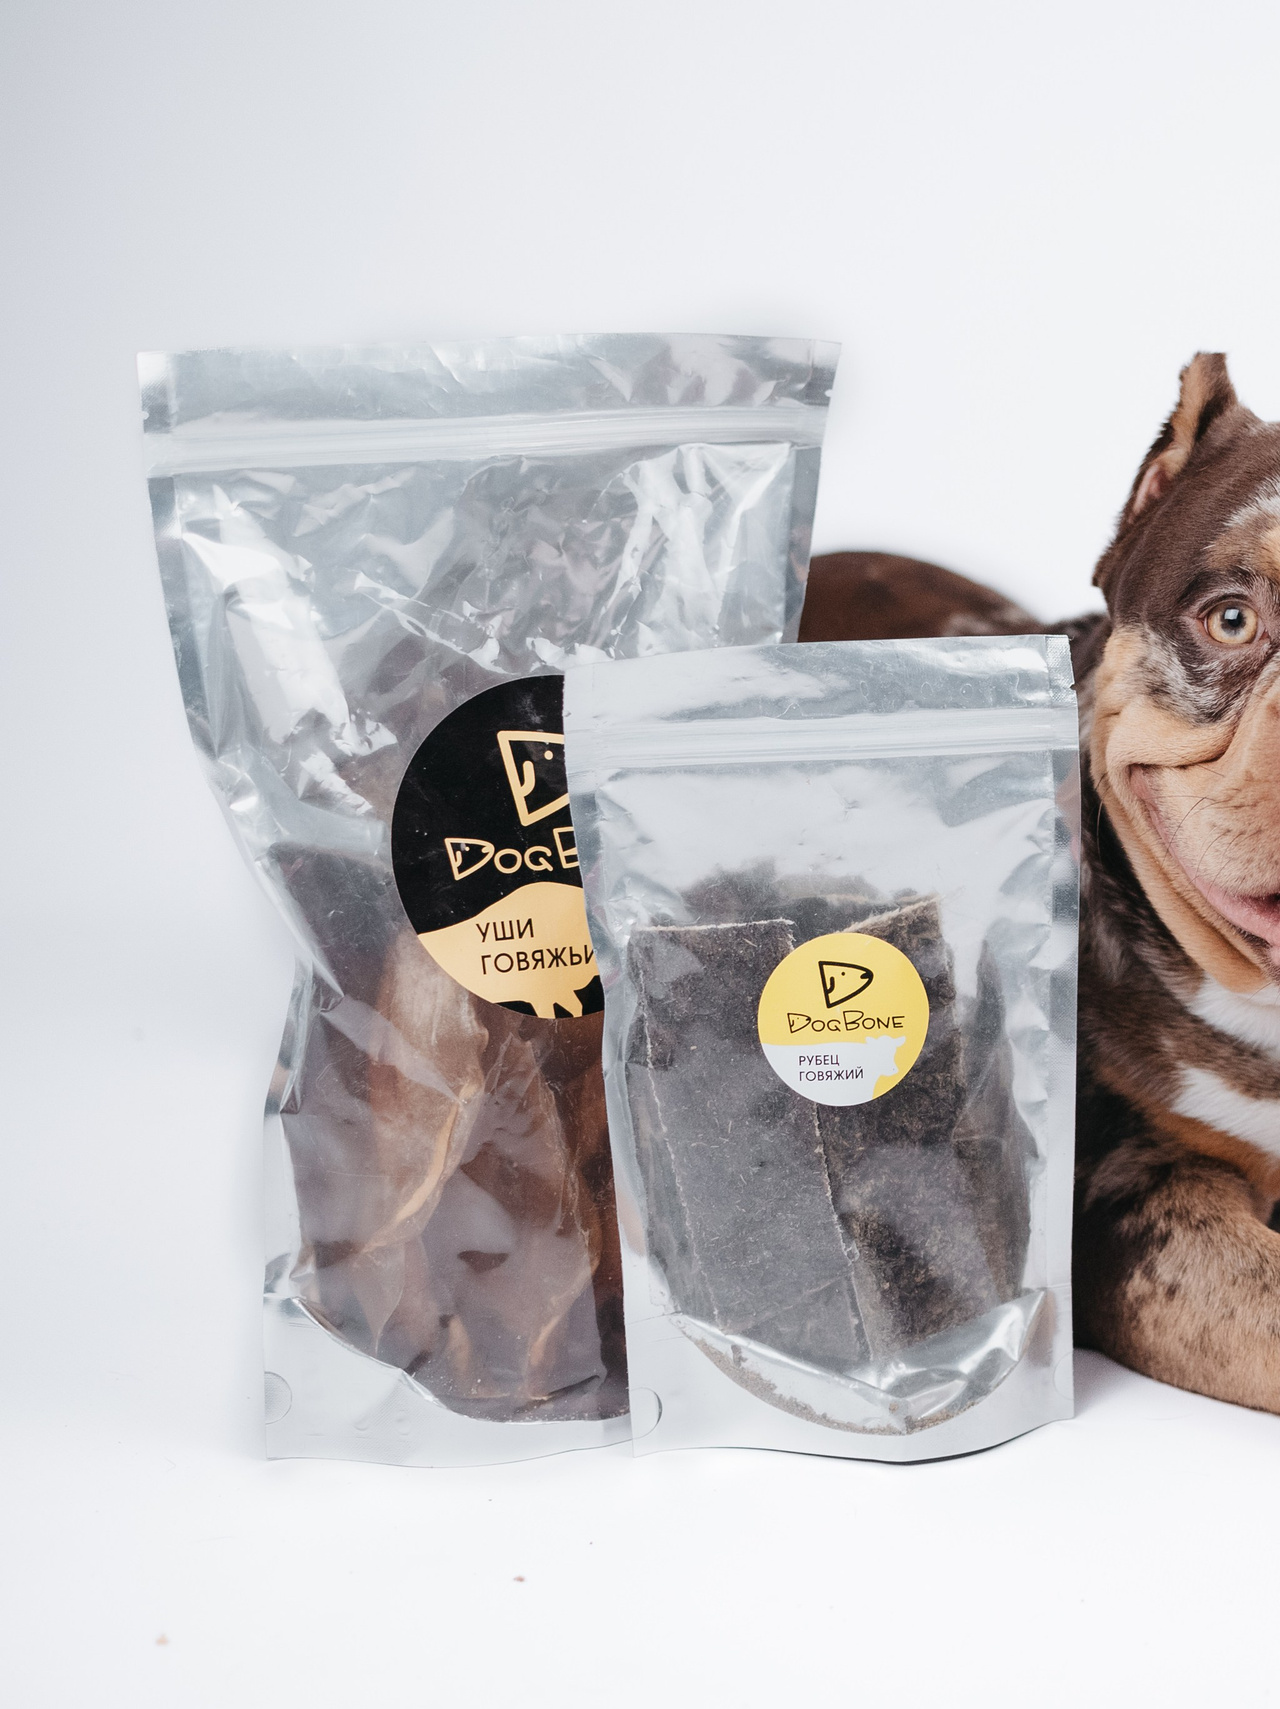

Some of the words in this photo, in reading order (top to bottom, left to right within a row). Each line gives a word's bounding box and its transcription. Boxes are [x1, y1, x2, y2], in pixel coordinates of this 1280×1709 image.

[444, 826, 581, 881] DOGB
[475, 917, 535, 943] УШИ
[798, 1054, 840, 1066] РУБЕЦ
[798, 1066, 864, 1082] ГОВЯЖИЙ
